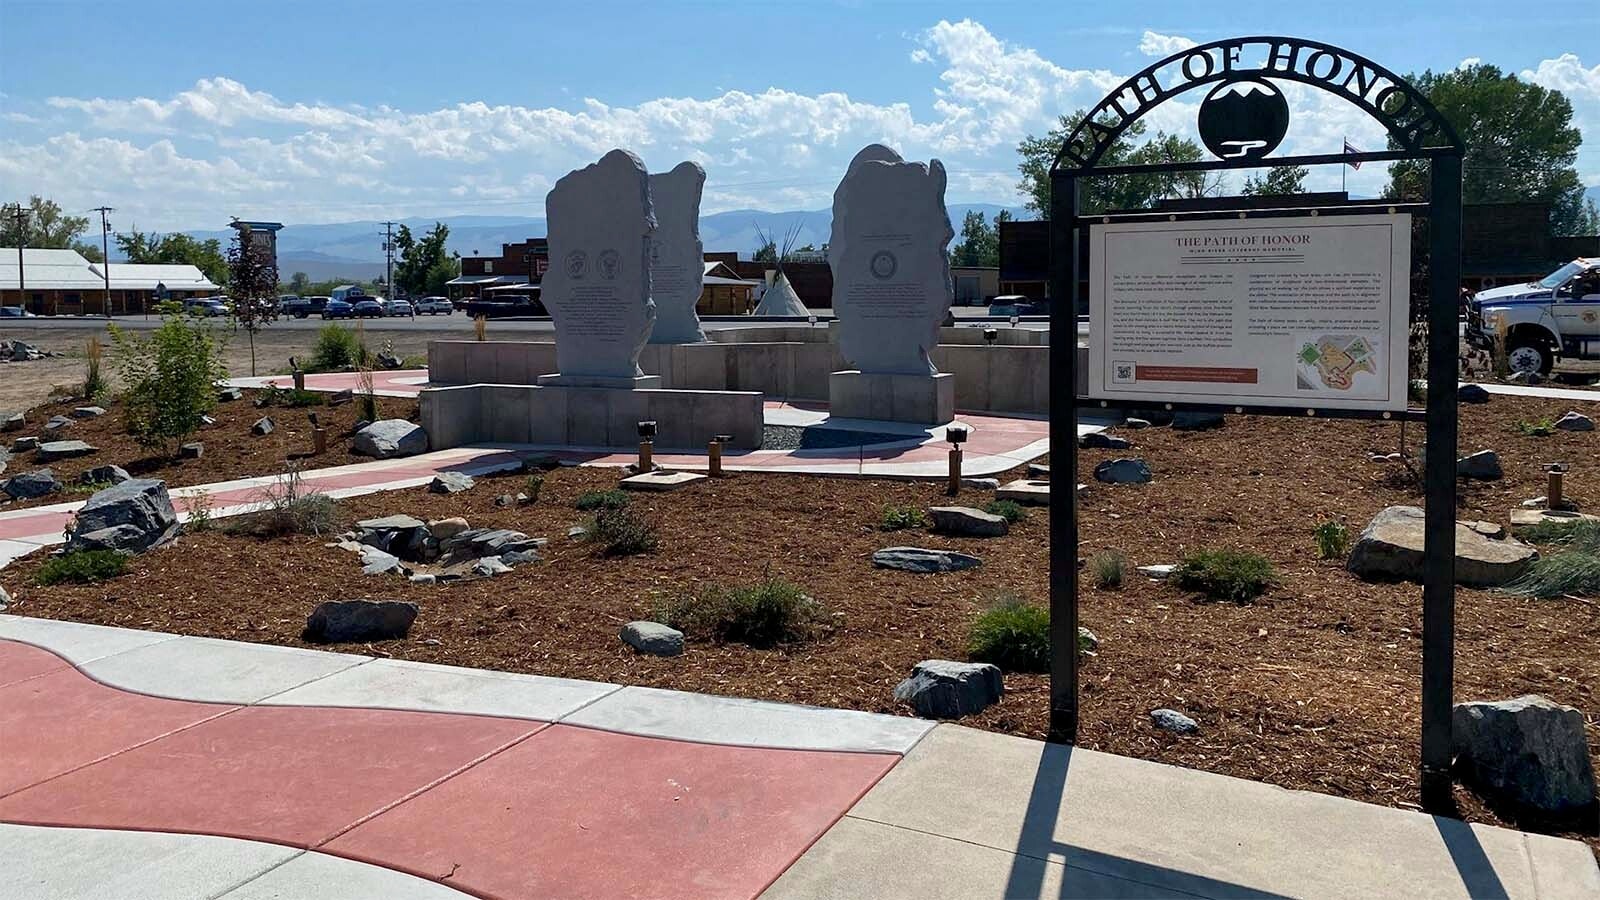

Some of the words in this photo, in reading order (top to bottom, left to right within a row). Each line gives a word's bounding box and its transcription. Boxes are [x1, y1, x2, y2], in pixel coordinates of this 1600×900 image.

[1064, 69, 1164, 166] PATH
[1182, 45, 1242, 81] OF
[1264, 43, 1434, 150] HONOR
[1176, 237, 1201, 247] THE
[1204, 236, 1238, 246] PATH
[1241, 236, 1259, 246] OF
[1262, 234, 1311, 245] HONOR
